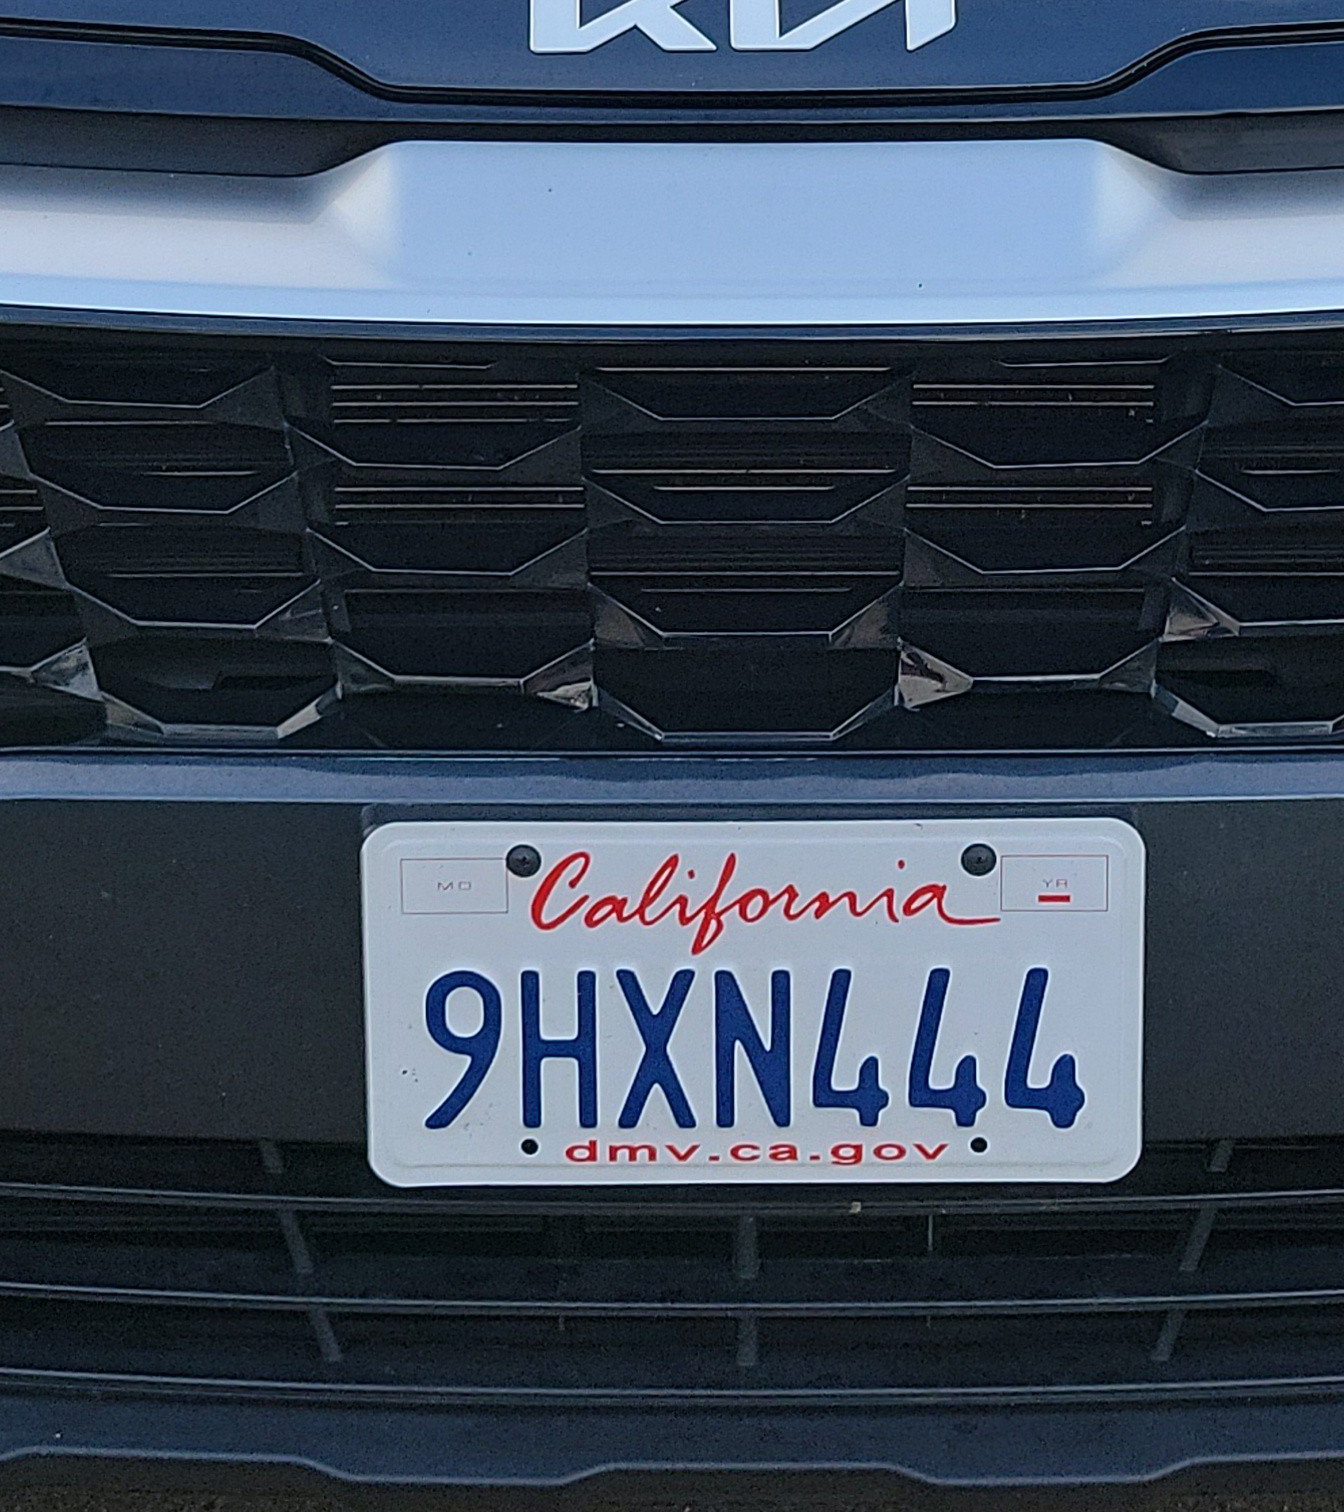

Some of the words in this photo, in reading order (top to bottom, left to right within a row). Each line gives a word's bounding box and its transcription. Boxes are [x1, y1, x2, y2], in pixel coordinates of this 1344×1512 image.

[437, 881, 472, 891] MO
[1042, 878, 1068, 889] YR
[529, 851, 997, 955] California
[424, 967, 1086, 1129] 9HXN444
[564, 1139, 949, 1165] dmv.ca.gov
